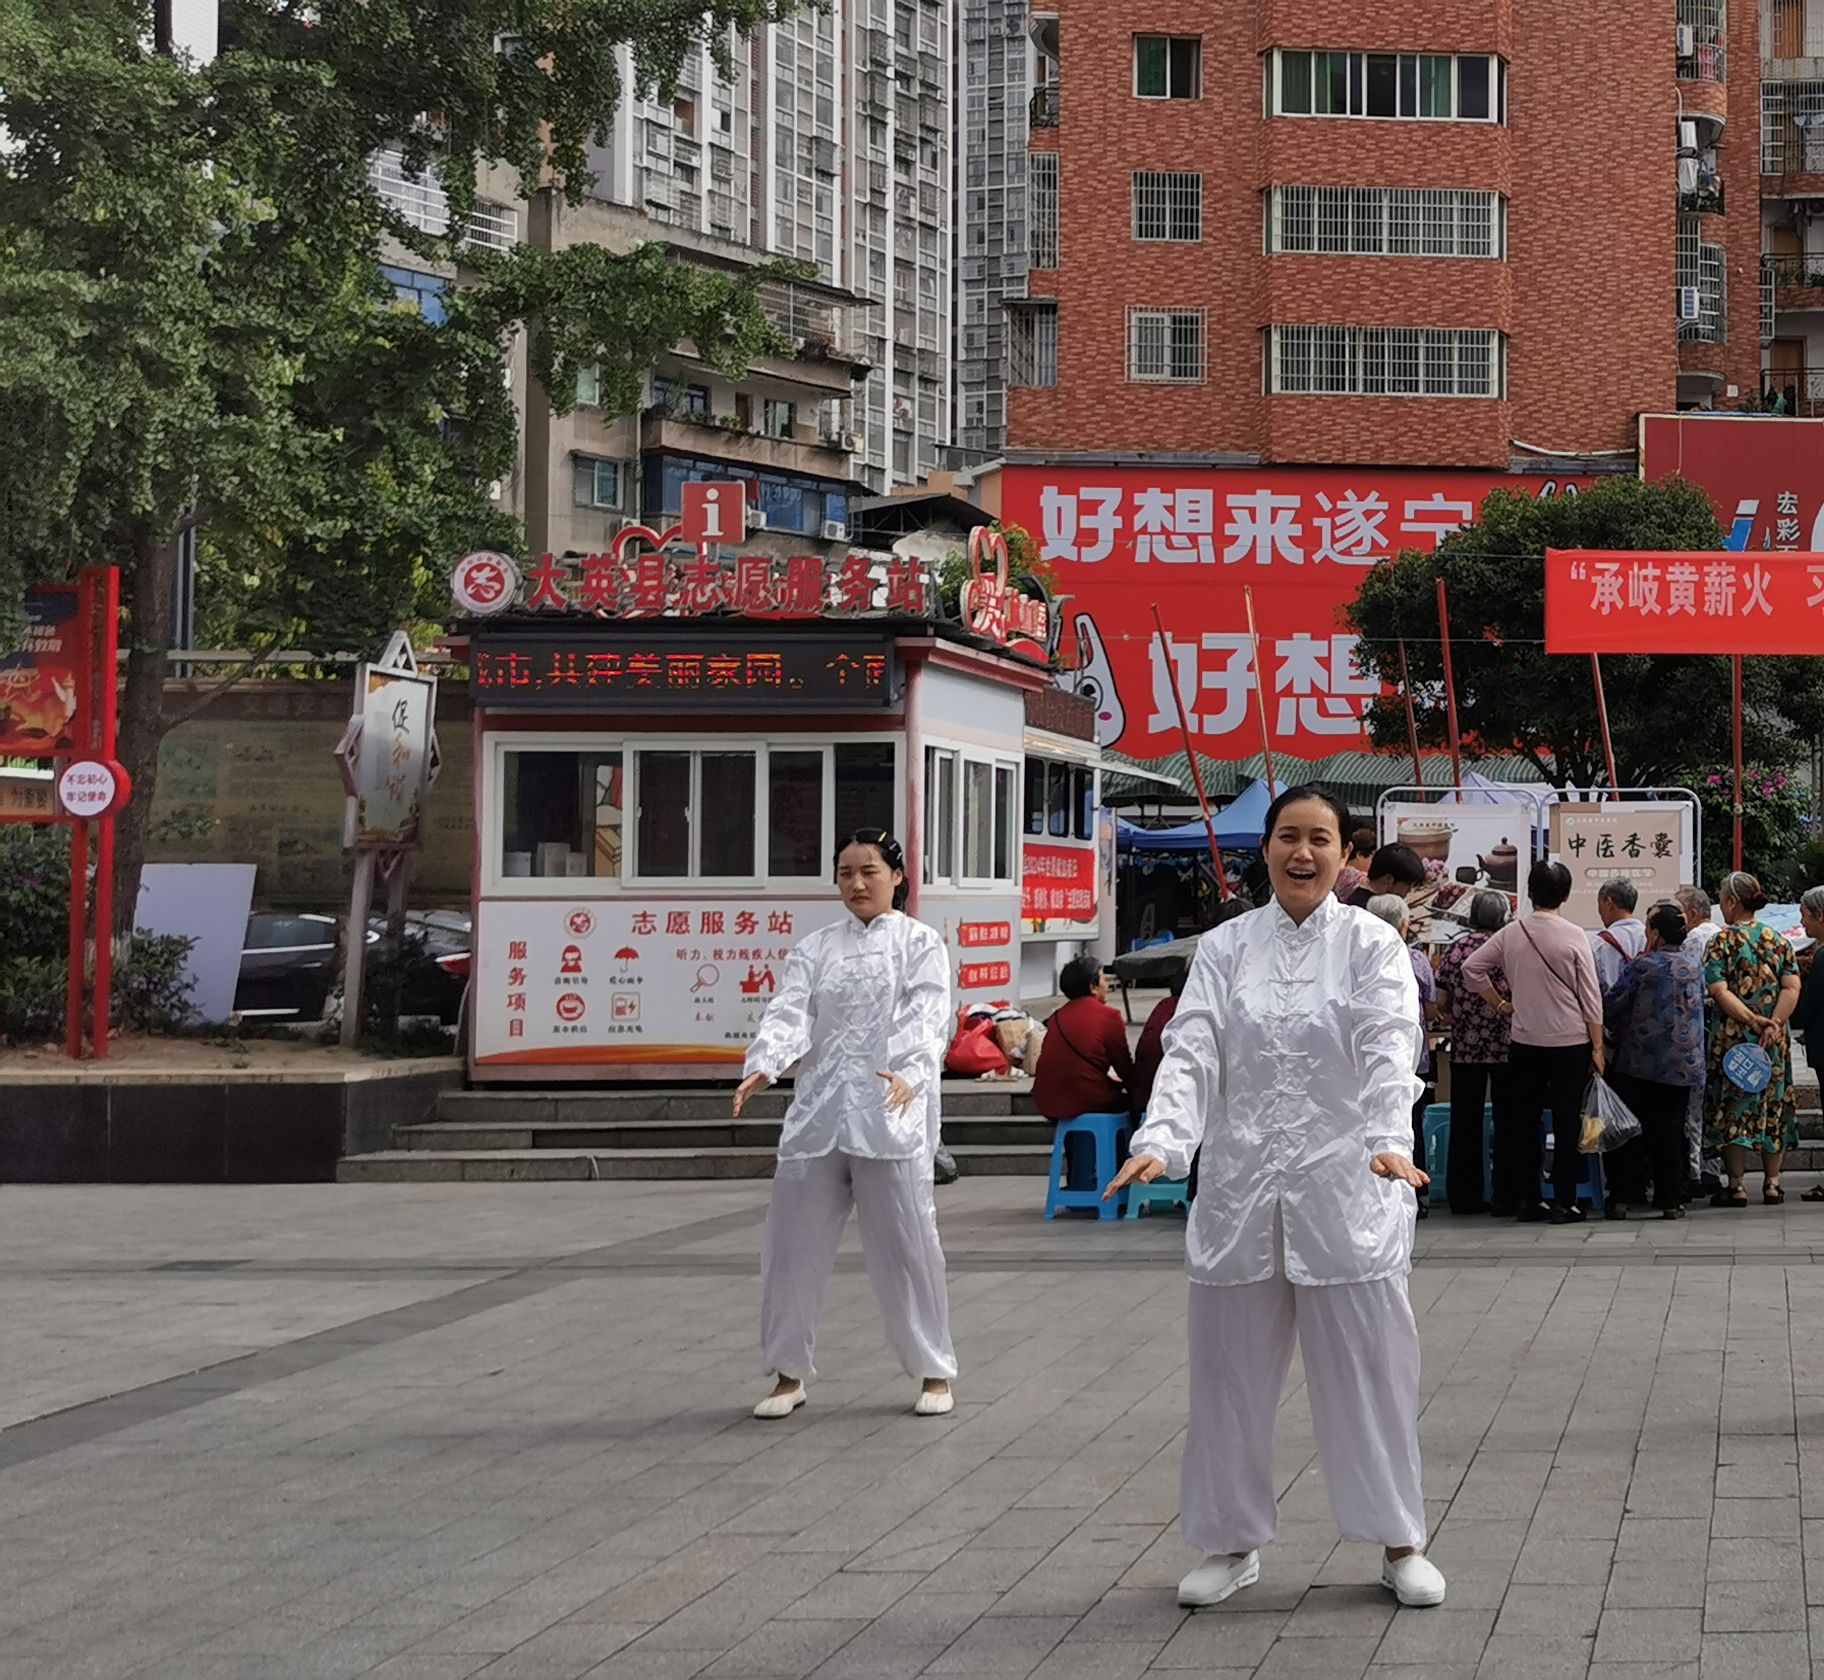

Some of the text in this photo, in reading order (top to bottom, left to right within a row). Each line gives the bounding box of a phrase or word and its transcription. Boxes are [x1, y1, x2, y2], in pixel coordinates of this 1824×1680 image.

[528, 552, 926, 611] 大英县志愿服务站
[1567, 832, 1675, 860] 中医香囊
[631, 910, 794, 935] 志愿服务站
[506, 941, 528, 1037] 服务项目
